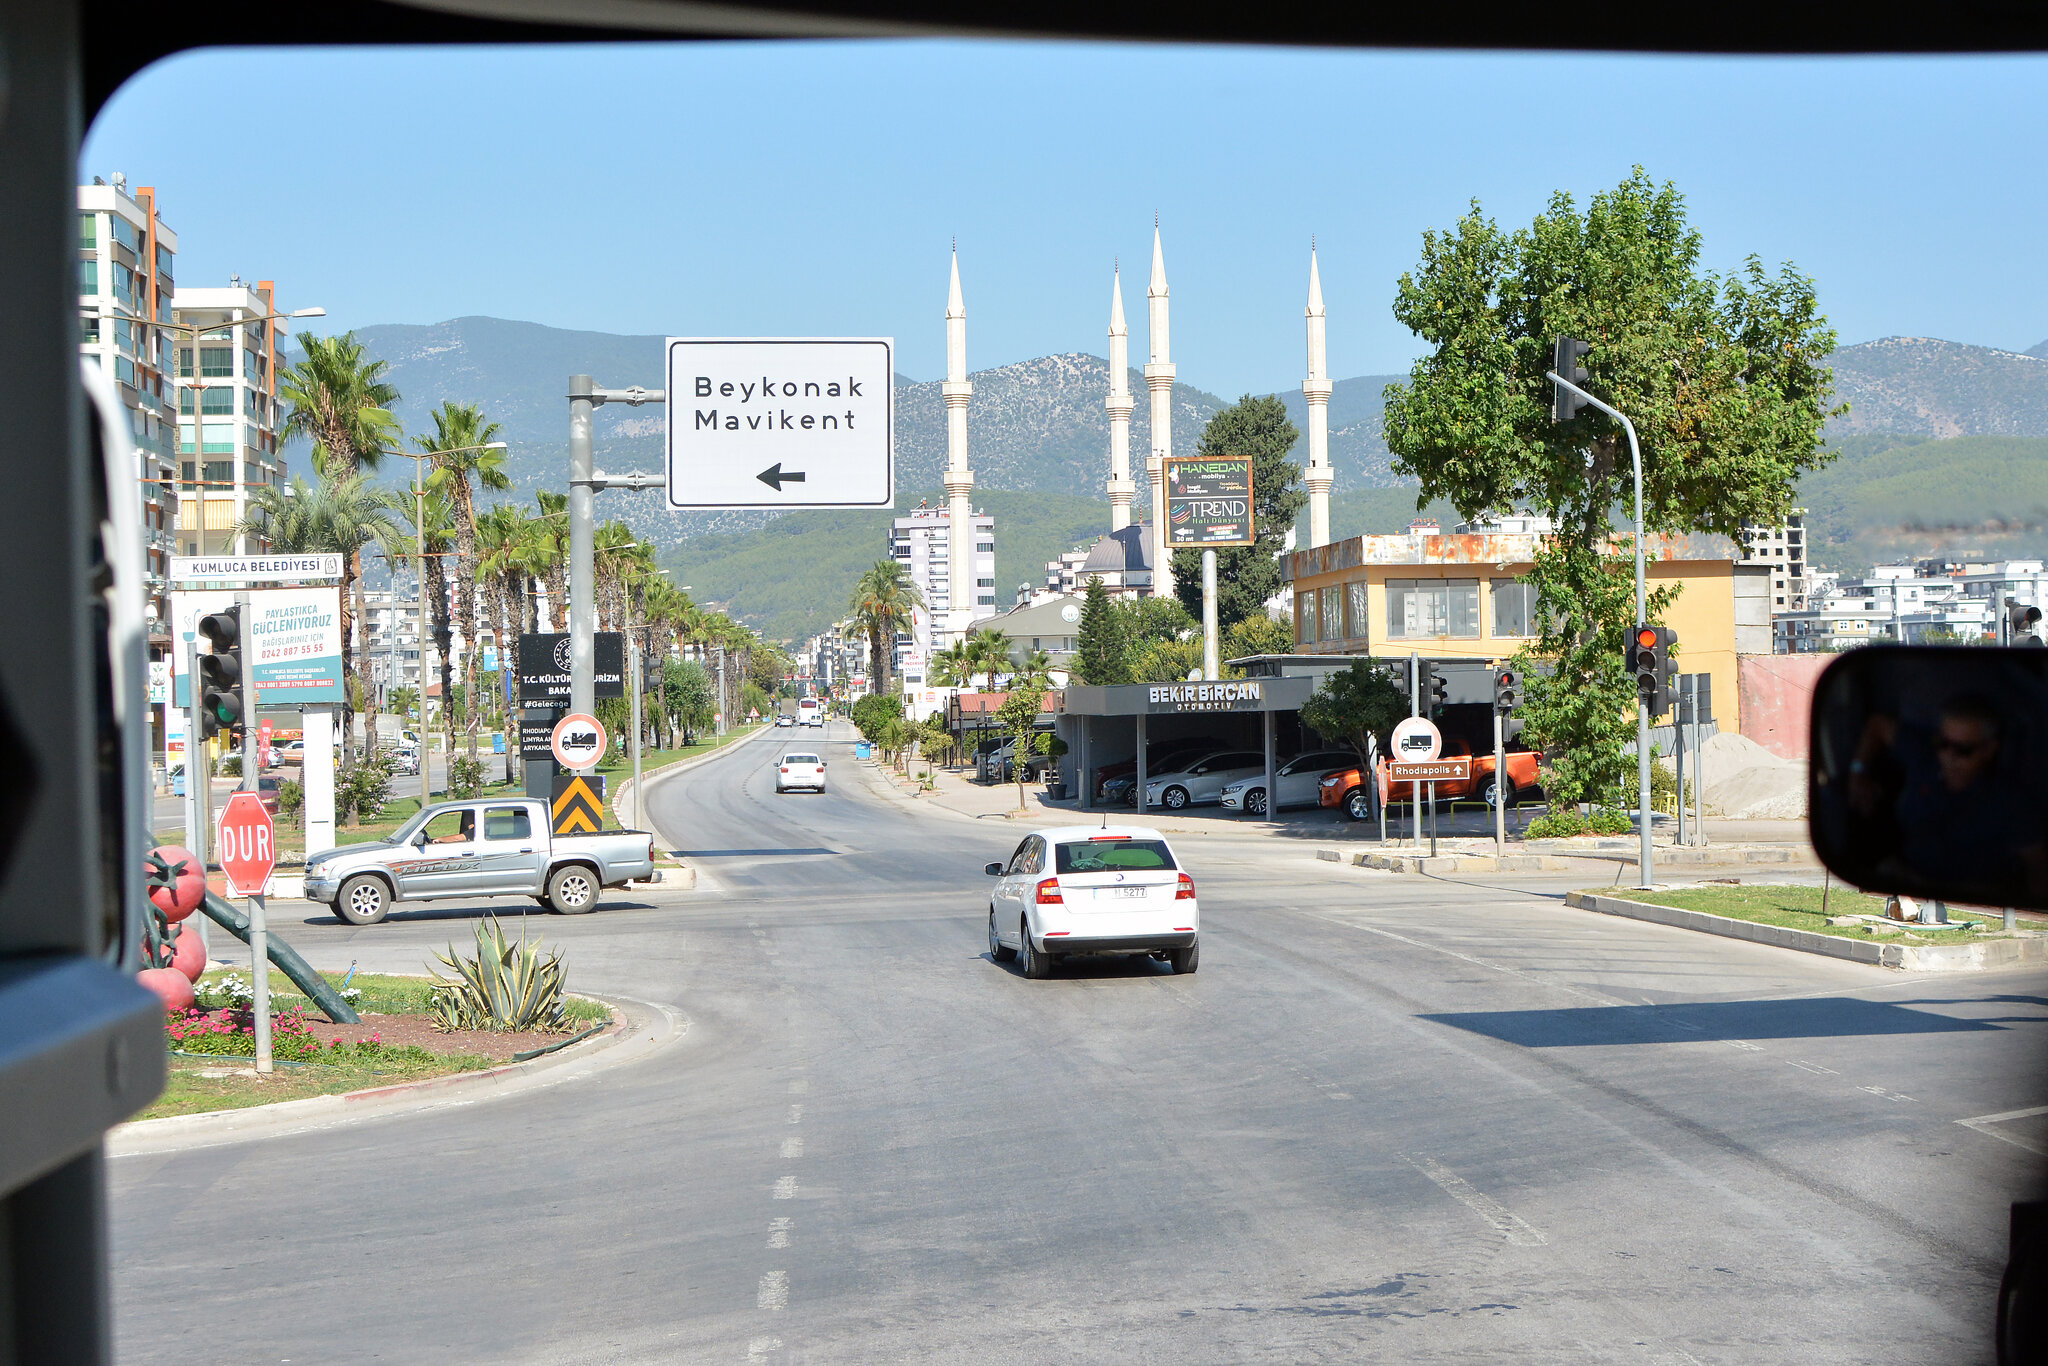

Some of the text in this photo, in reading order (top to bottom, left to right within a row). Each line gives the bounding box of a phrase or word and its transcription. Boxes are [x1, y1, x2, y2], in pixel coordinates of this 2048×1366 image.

[695, 376, 863, 403] Beykonak
[695, 409, 855, 430] Mavikent
[1180, 462, 1247, 474] HANEDAN
[1188, 500, 1246, 517] TREND
[1211, 517, 1245, 525] Dünyası
[192, 557, 320, 574] KUMLUCA BELEDİYESİ
[265, 604, 318, 619] PAYLAŞTIKÇA
[252, 614, 332, 635] GÜÇLENİYORUZ
[262, 632, 324, 647] BAĞIŞLARINIZ İÇİN
[261, 648, 281, 659] 0242
[301, 645, 311, 654] 55
[314, 643, 324, 653] 55
[522, 673, 620, 683] T.C. KÜLTÜR URİZM
[548, 686, 571, 695] BAKA
[1149, 682, 1260, 703] BEKİR BİRCAN
[1395, 765, 1450, 776] Rhodiapolis
[223, 824, 270, 862] DUR
[1123, 887, 1145, 897] 5277
